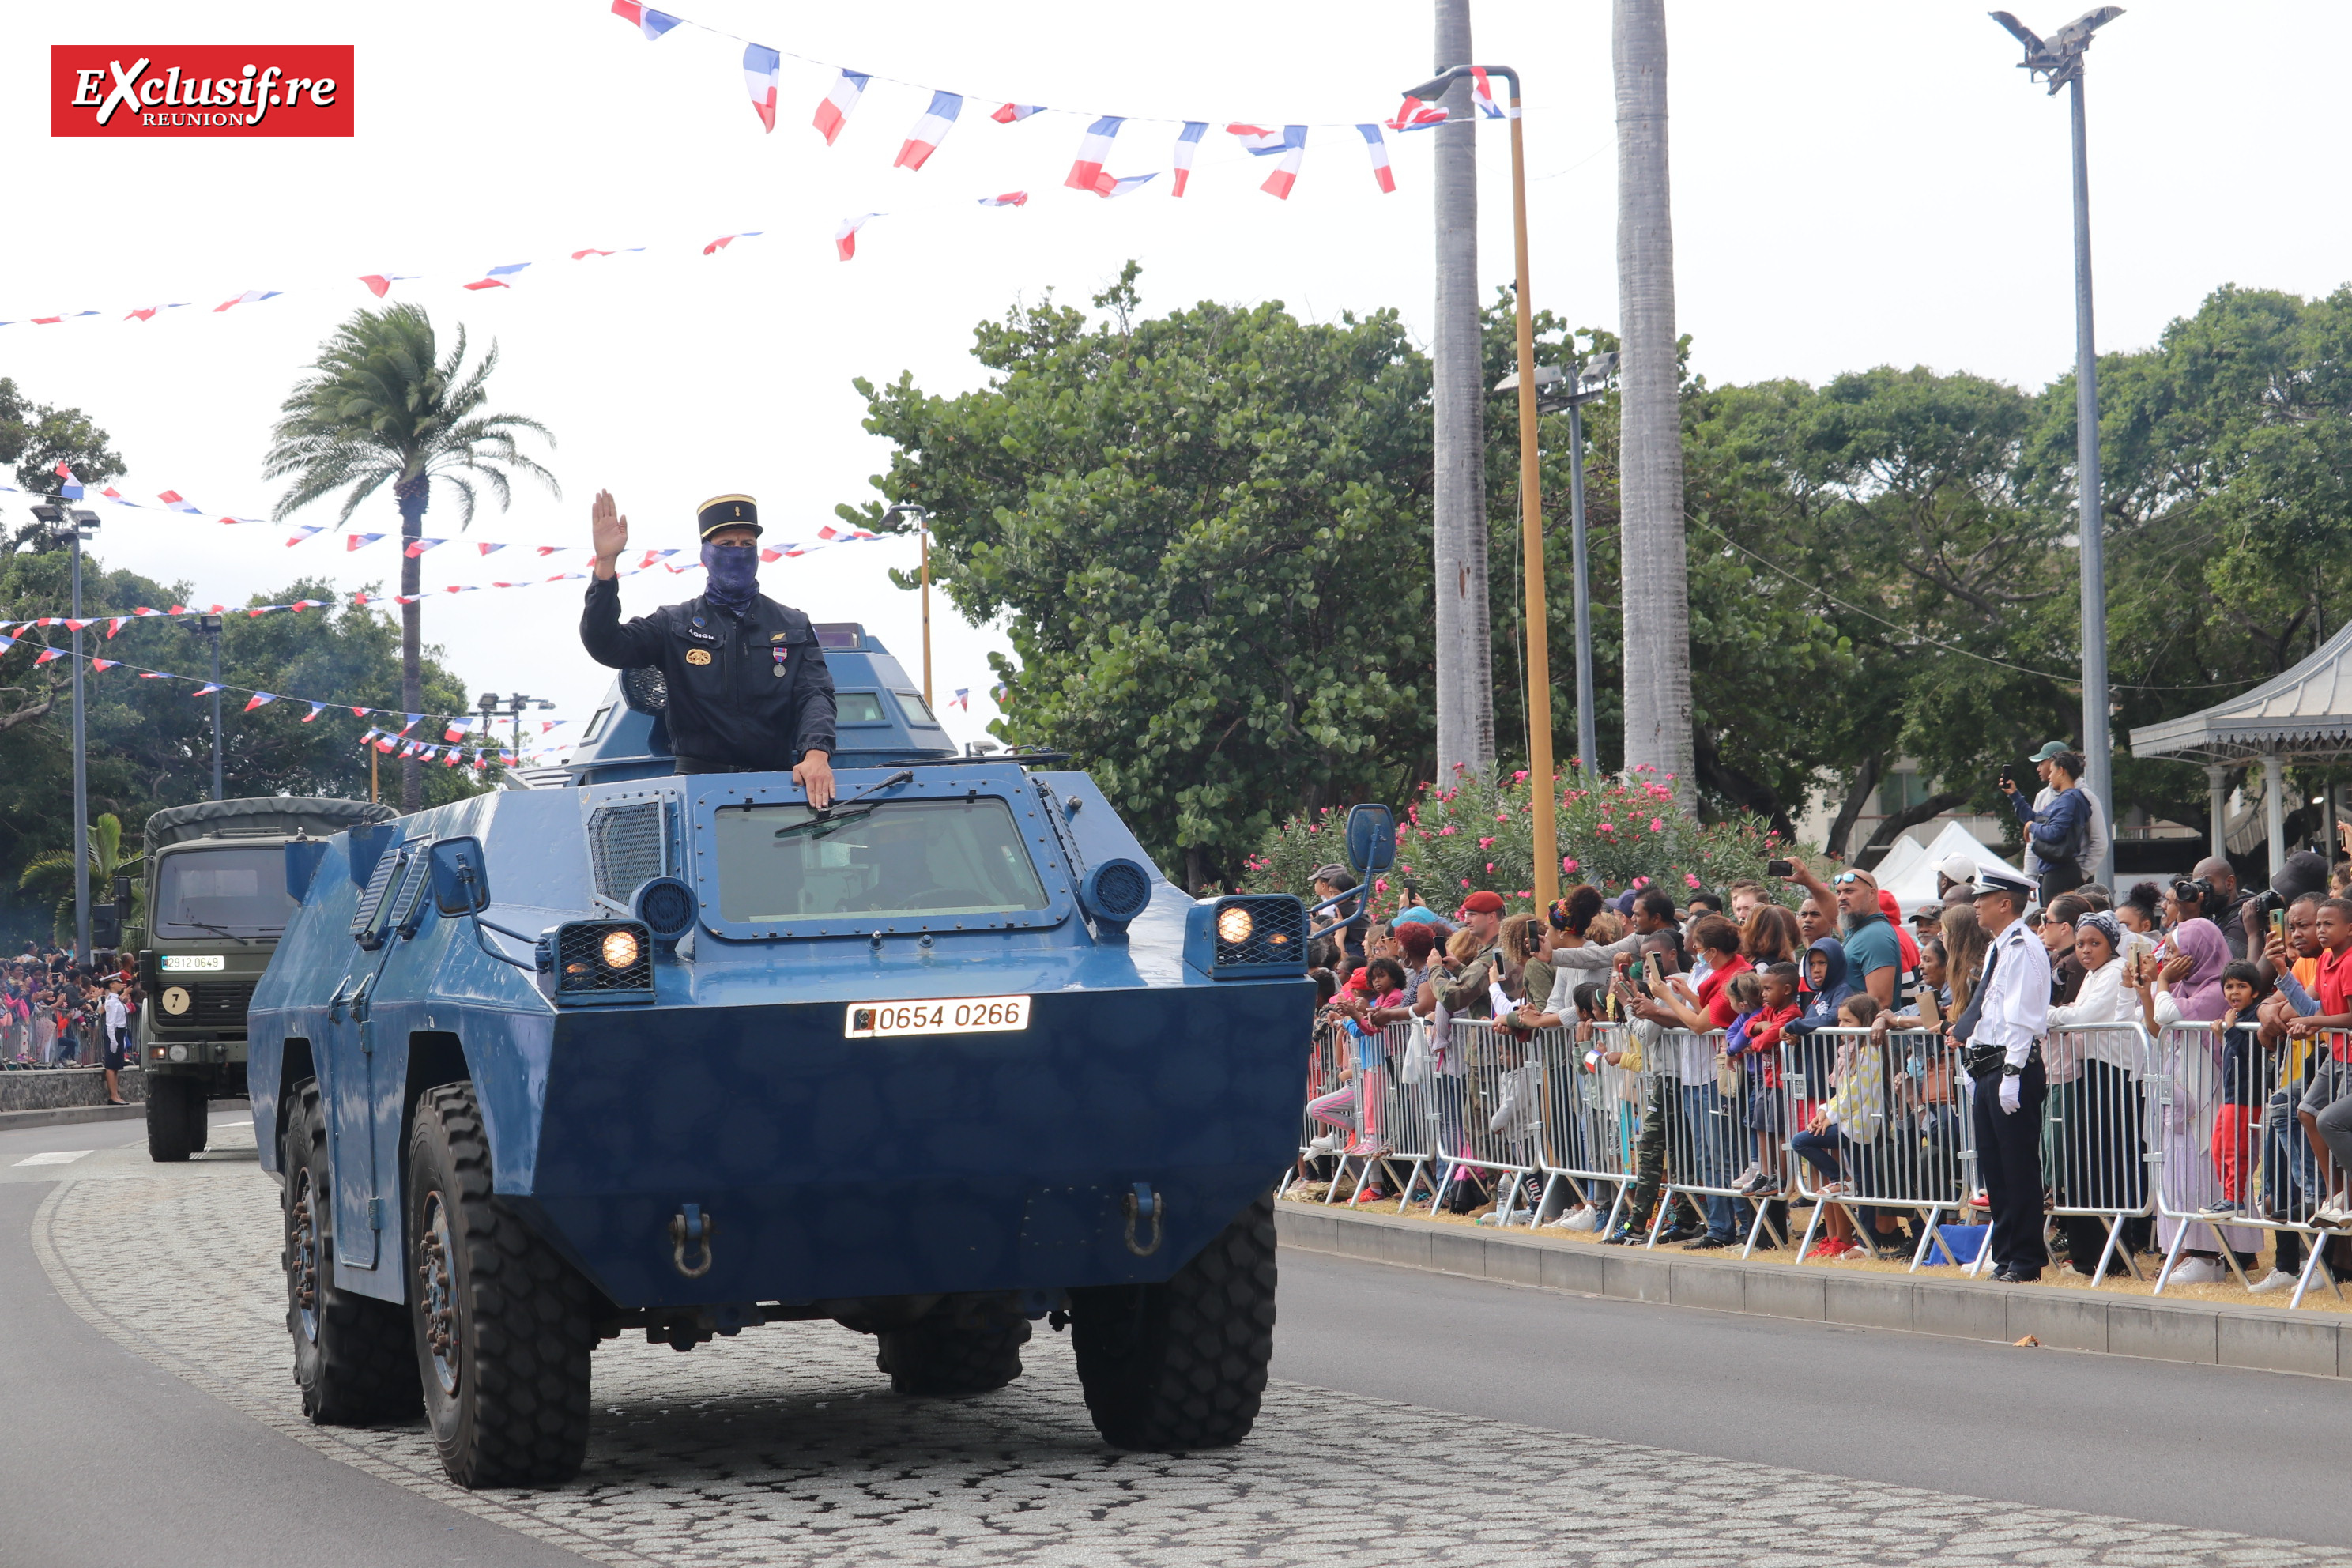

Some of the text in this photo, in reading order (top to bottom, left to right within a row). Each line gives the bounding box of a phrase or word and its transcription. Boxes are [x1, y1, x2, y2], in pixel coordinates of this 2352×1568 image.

[168, 957, 218, 968] 2912 0649
[172, 993, 179, 1008] 7
[879, 1002, 1020, 1030] 0654 0266
[1525, 1178, 1543, 1202] LULU
